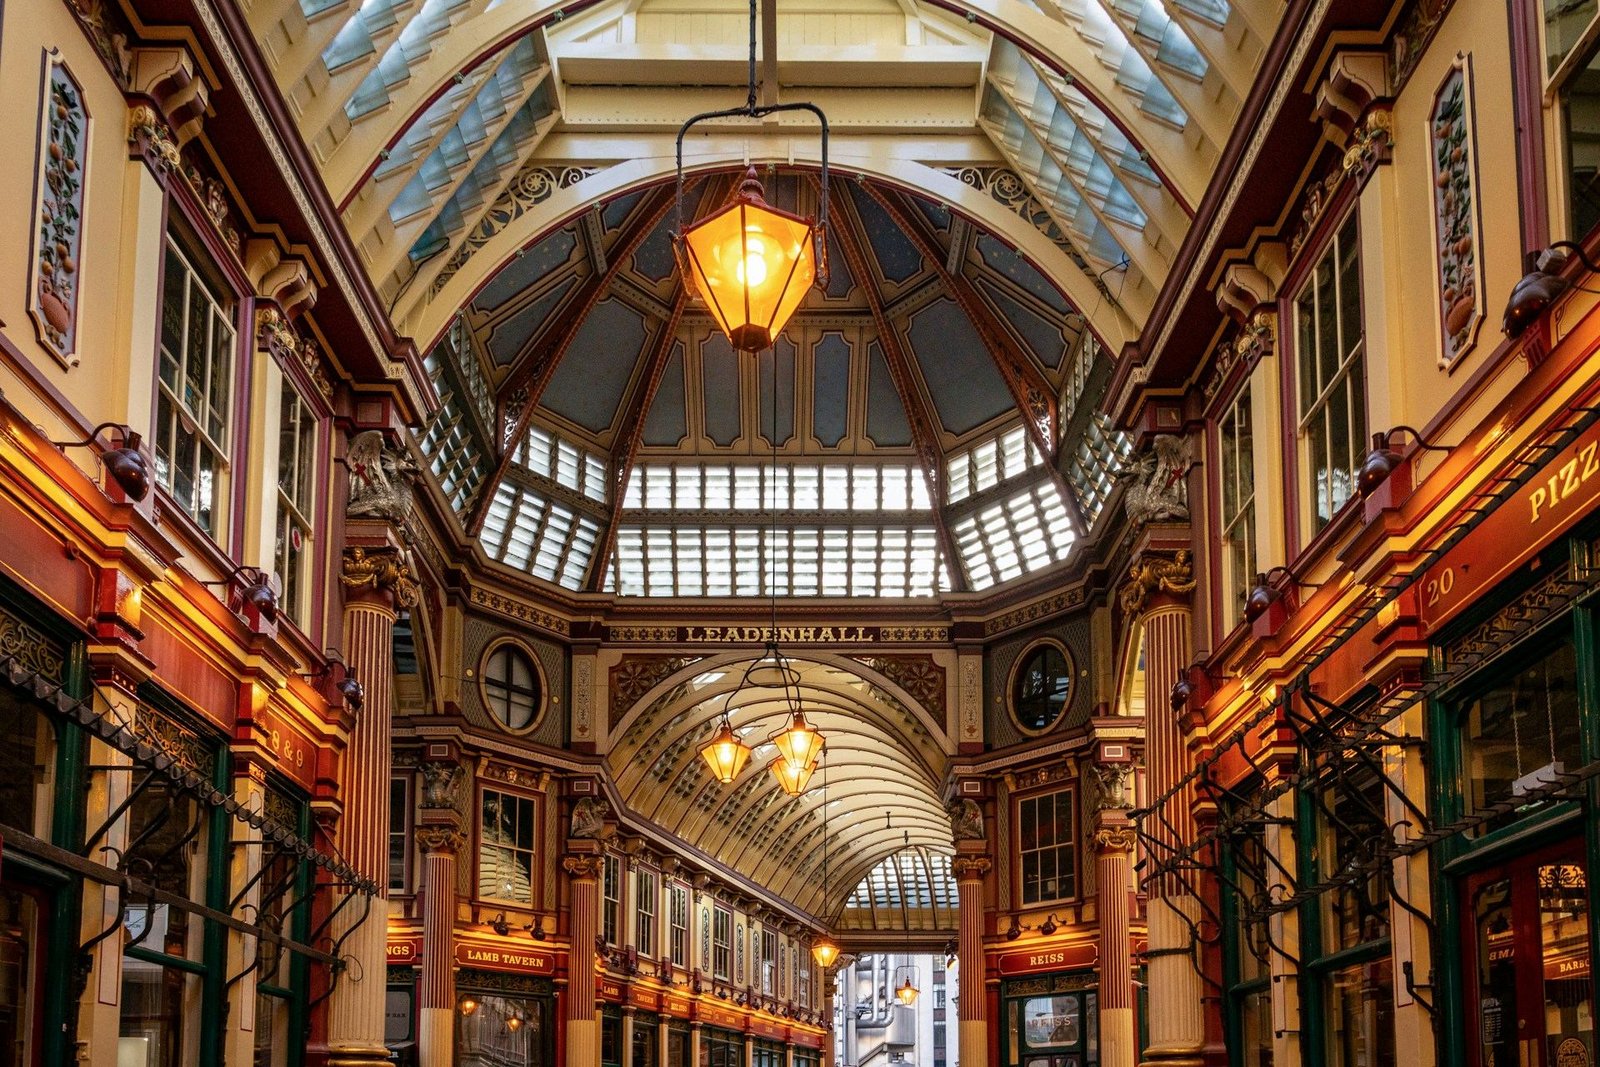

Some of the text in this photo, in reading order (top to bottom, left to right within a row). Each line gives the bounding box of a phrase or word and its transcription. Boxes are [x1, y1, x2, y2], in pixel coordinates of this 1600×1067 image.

[1427, 567, 1455, 607] 20
[685, 627, 873, 642] LEADENHALL
[272, 730, 303, 768] 8 & 9
[467, 950, 544, 968] LAMB TAVERN
[1030, 953, 1064, 965] REISS
[603, 986, 619, 996] LAMB
[1031, 1016, 1071, 1027] REISS
